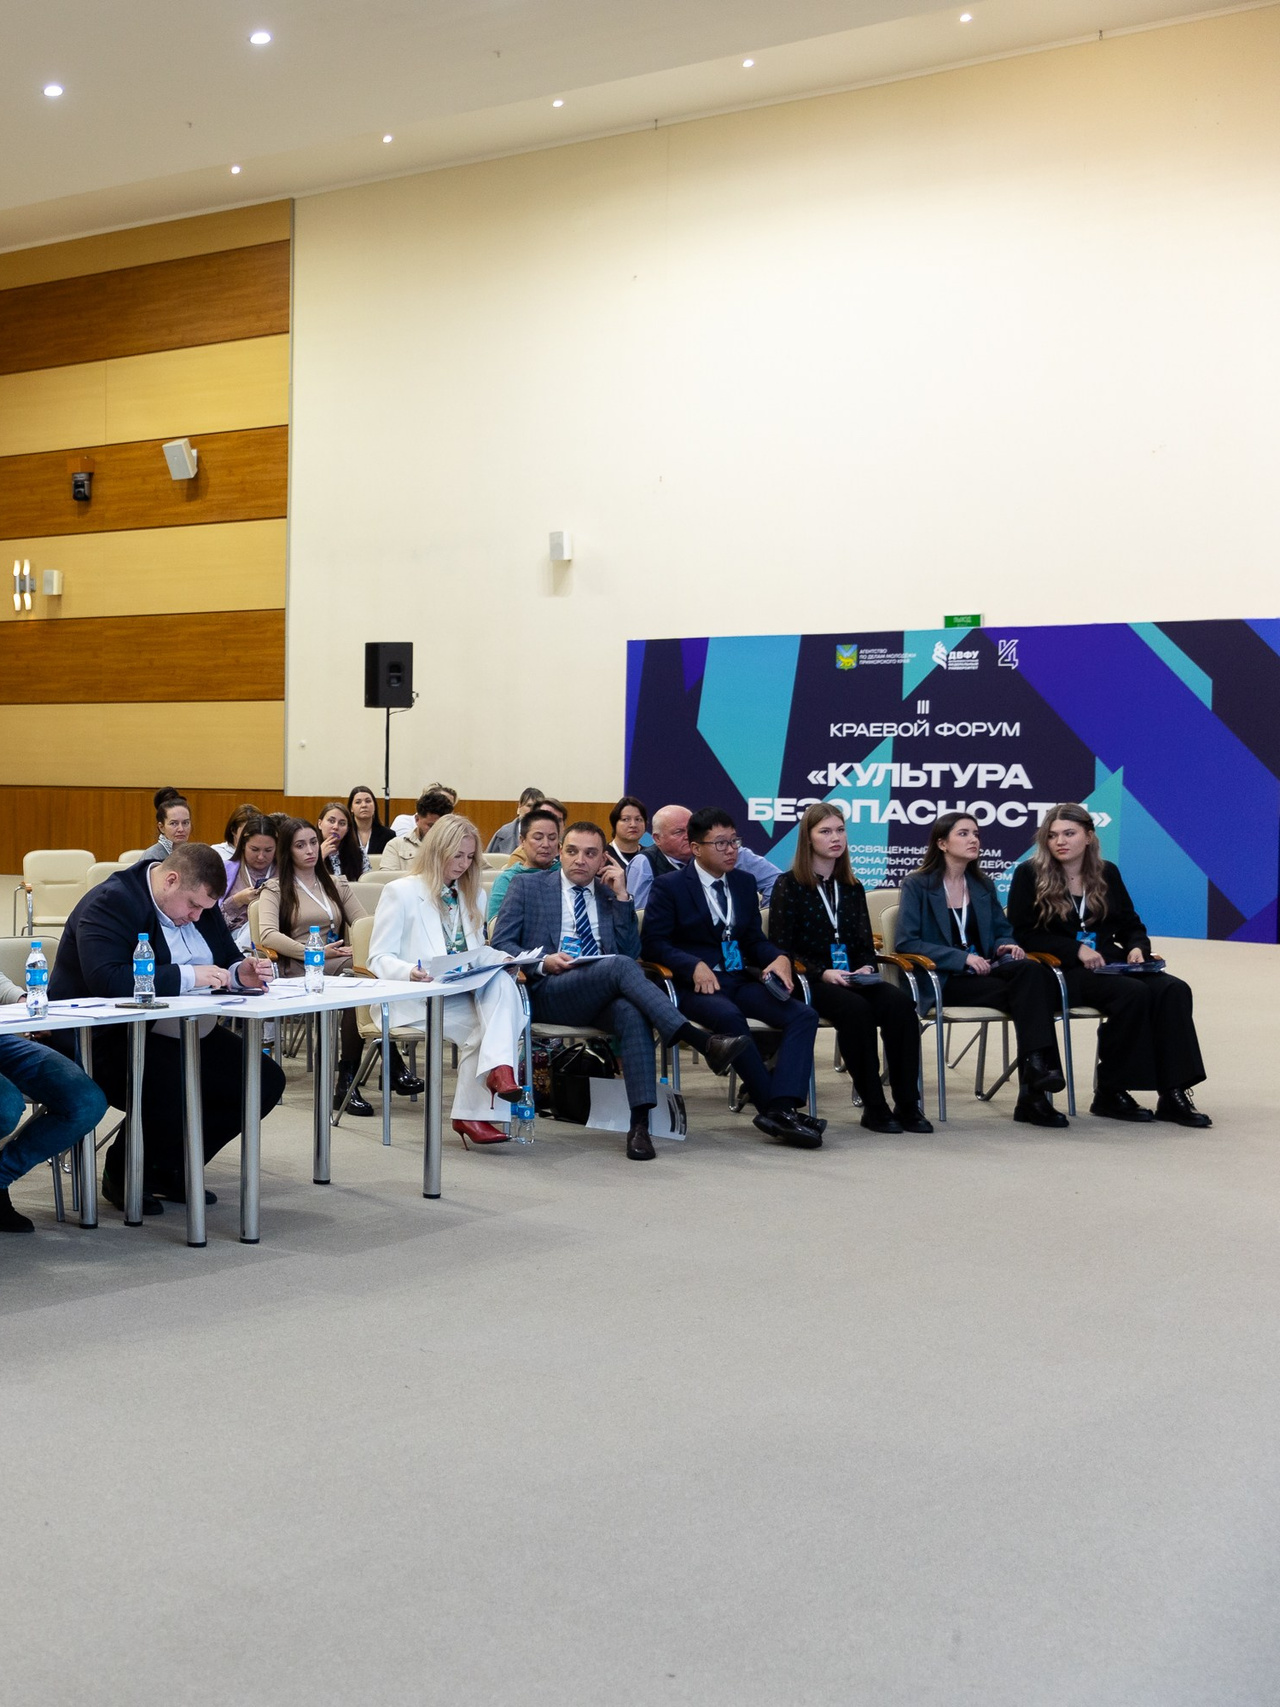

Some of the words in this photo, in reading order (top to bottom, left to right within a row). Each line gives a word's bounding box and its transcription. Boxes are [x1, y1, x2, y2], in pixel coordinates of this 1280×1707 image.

[948, 650, 980, 660] ДВФУ
[917, 700, 930, 715] III
[829, 719, 930, 738] КРАЕВОЙ
[934, 721, 1021, 738] ФОРУМ
[806, 762, 1034, 790] «КУЛЬТУРА
[847, 844, 930, 855] ОСВЯЩЕННЫЙ
[850, 855, 925, 866] ИОНАЛЬНОГО
